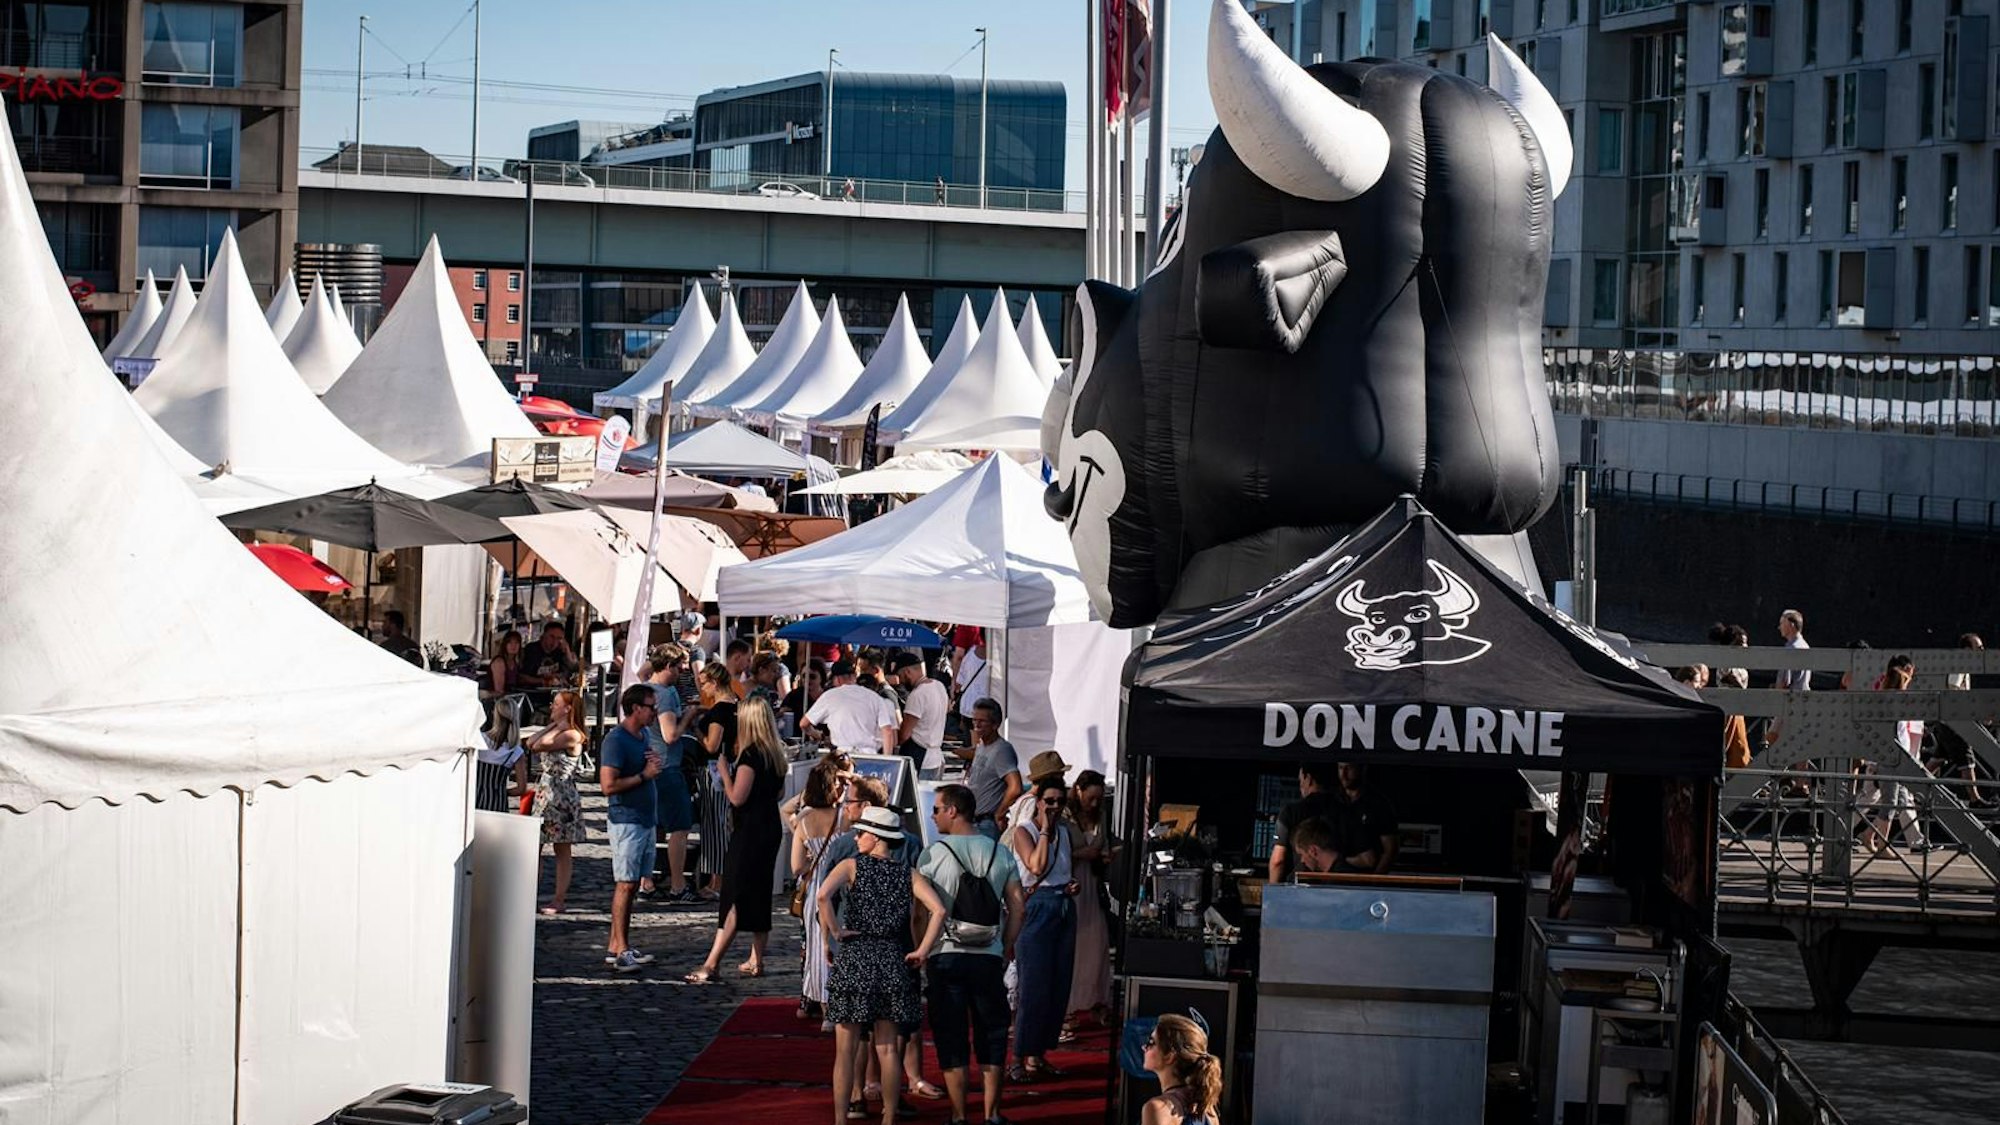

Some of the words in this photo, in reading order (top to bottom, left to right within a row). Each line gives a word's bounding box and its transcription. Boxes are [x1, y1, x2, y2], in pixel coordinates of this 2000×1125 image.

[880, 626, 913, 638] GROM
[1263, 702, 1377, 750] DON
[1391, 704, 1566, 757] CARNE
